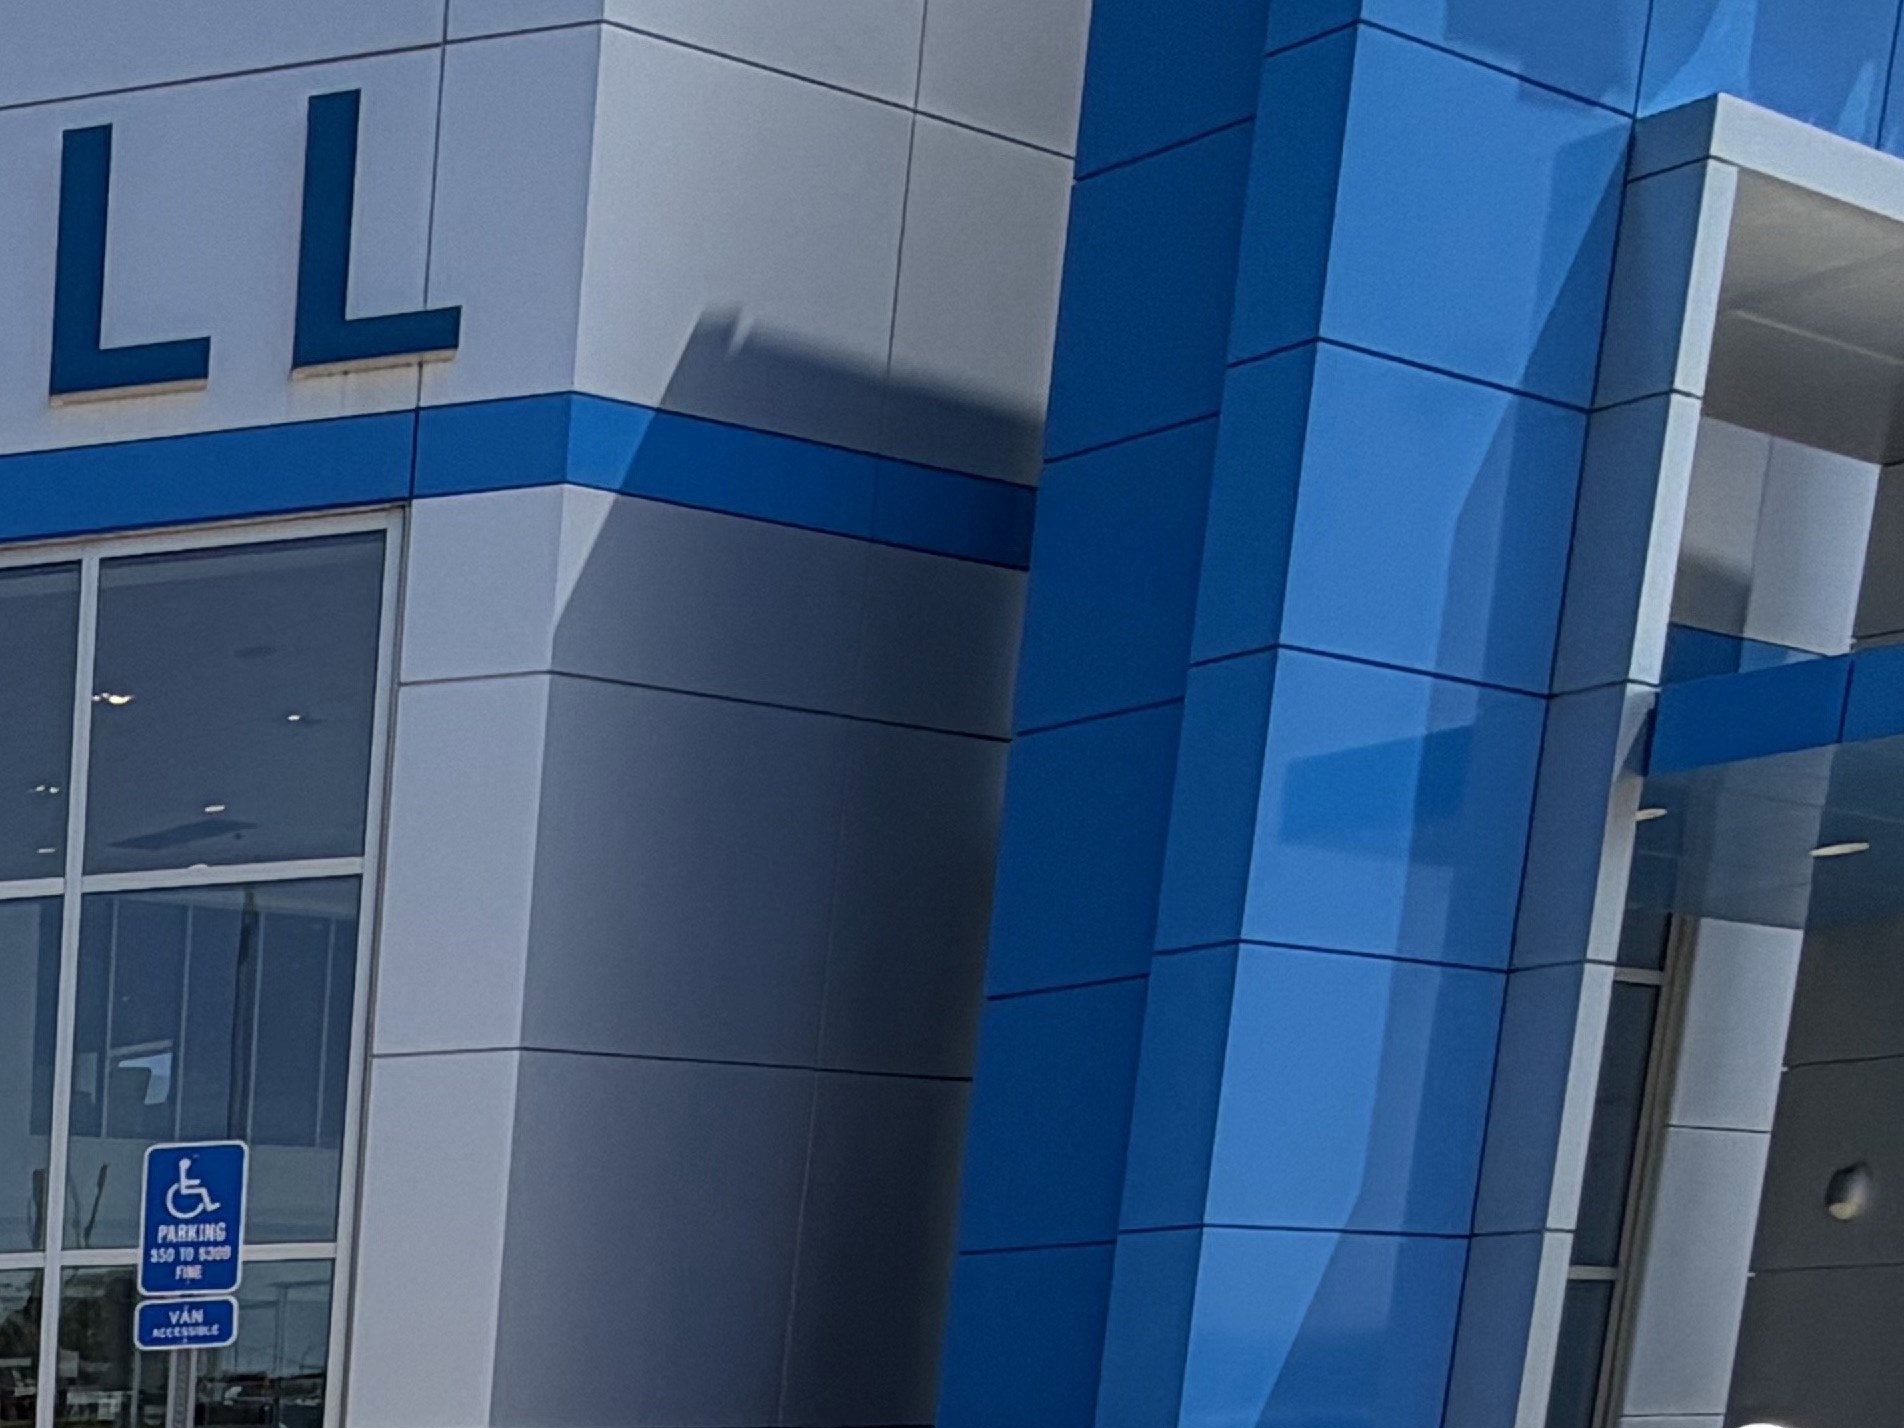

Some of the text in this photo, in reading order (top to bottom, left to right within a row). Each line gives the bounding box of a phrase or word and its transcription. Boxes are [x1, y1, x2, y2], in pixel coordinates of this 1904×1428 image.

[157, 1222, 226, 1243] PARKING
[179, 1246, 194, 1261] TO
[174, 1264, 202, 1280] FINE
[168, 1309, 204, 1325] VAN
[152, 1323, 220, 1337] ACCESSIBLE
